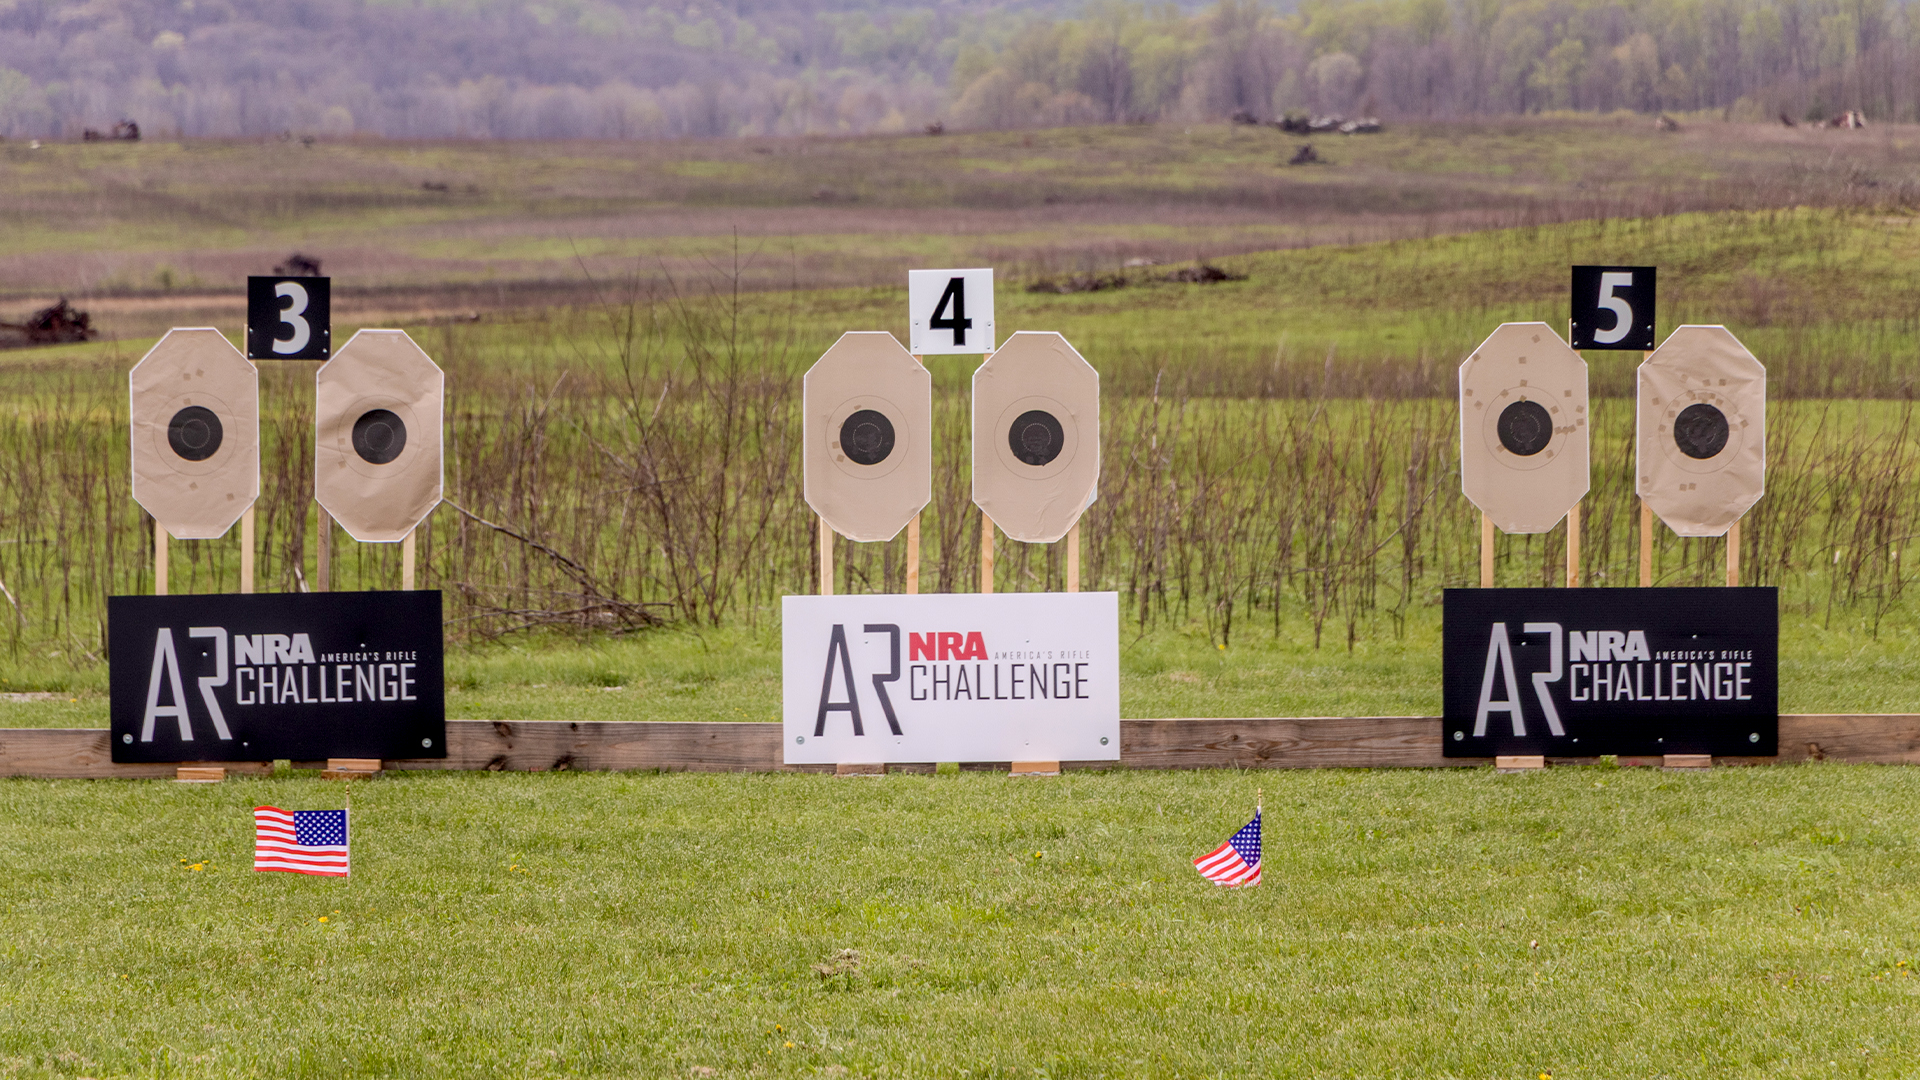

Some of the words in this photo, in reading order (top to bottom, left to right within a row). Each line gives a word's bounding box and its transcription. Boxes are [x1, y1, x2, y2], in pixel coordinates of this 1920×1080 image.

[272, 281, 310, 355] 3
[929, 276, 972, 346] 4
[1593, 271, 1633, 344] 5
[234, 633, 316, 665] NRA
[320, 652, 380, 663] AMERICA'S
[386, 650, 418, 661] RIFLE
[909, 631, 989, 661] NRA
[994, 651, 1053, 660] AMERICA'S
[1060, 650, 1090, 660] RIFLE
[1569, 630, 1651, 662] NRA
[1655, 650, 1715, 661] AMERICA'S
[1721, 649, 1753, 661] RIFLE
[141, 626, 233, 742] AR
[235, 663, 418, 705] CHALLENGE
[814, 623, 904, 737] AR
[910, 662, 1090, 701] CHALLENGE
[1473, 622, 1566, 737] AR
[1570, 662, 1753, 701] CHALLENGE
